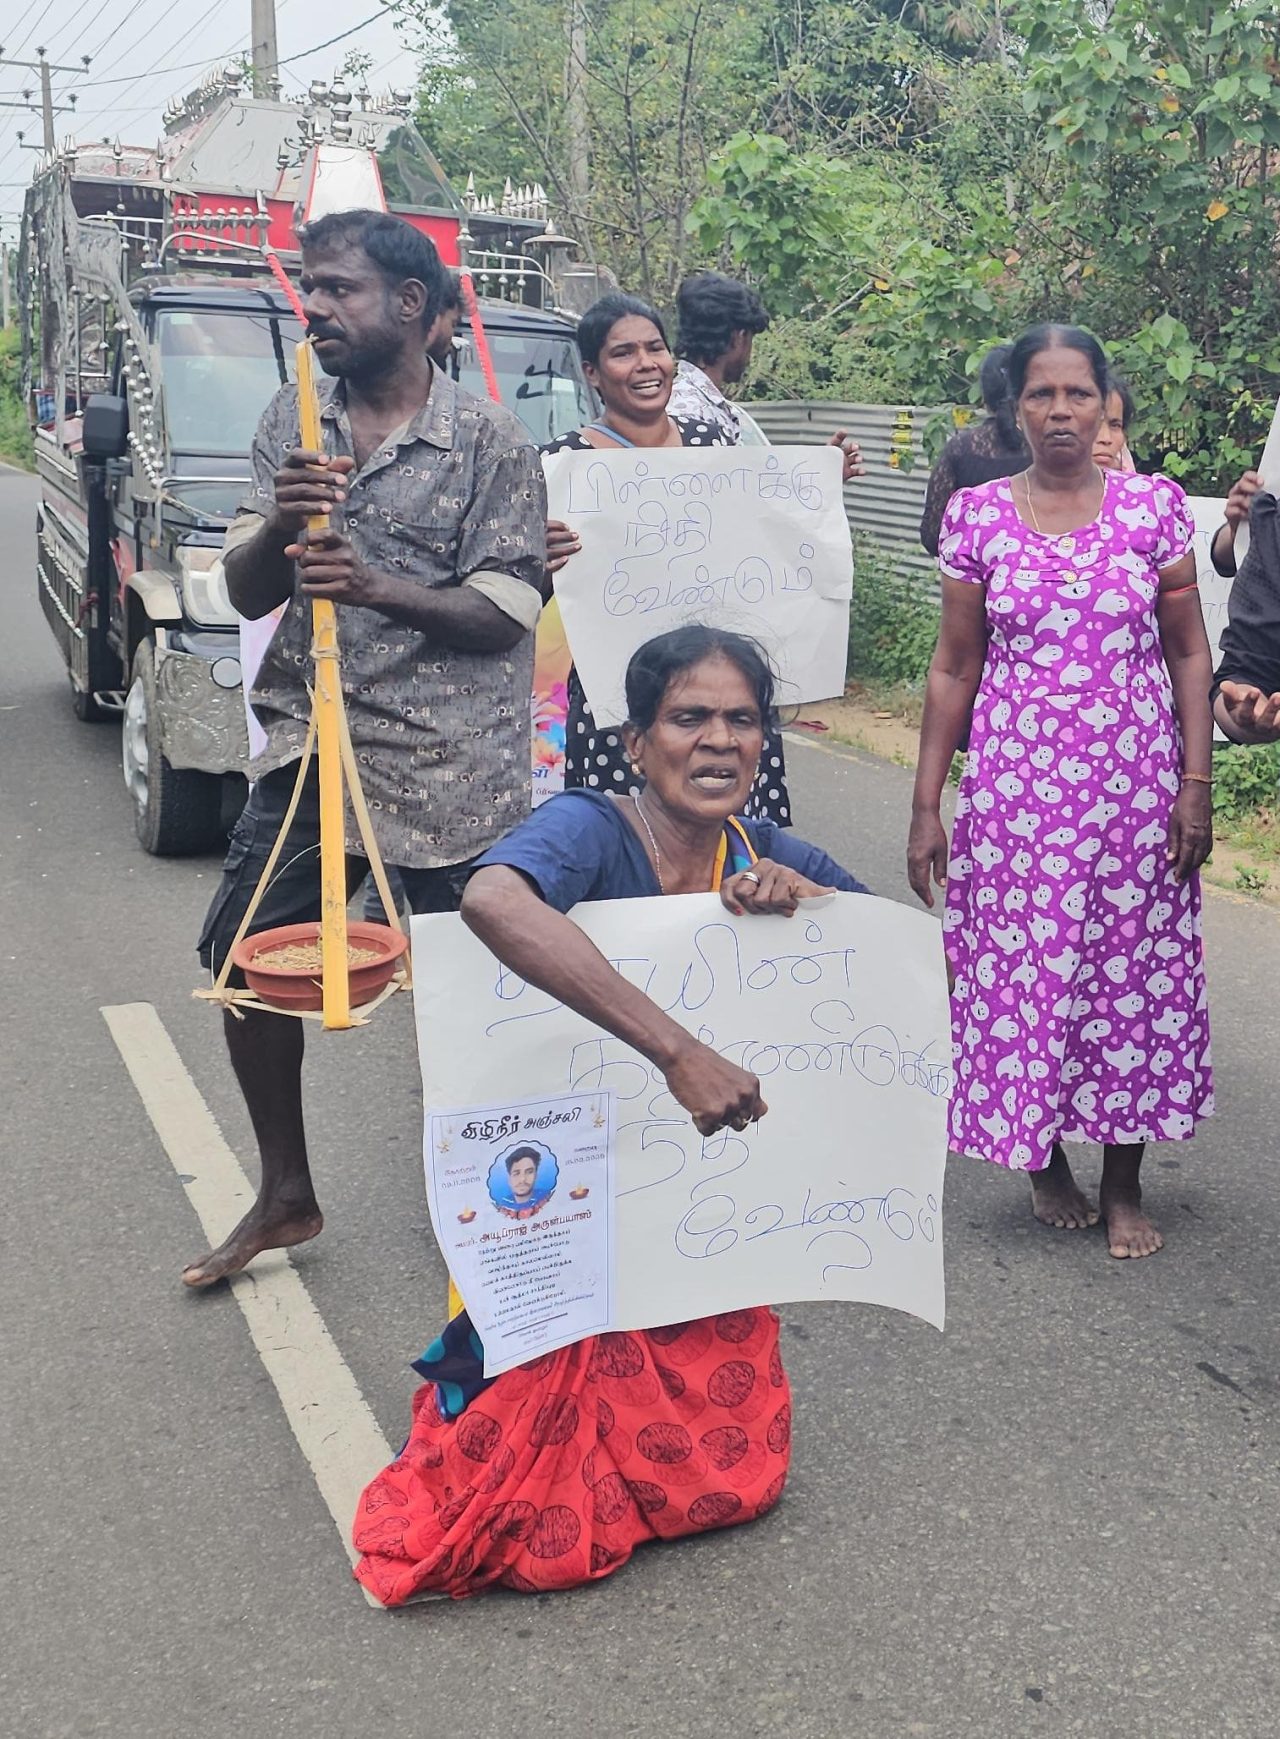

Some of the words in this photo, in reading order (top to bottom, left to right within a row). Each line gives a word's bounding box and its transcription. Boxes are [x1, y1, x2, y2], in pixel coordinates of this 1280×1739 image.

[603, 543, 815, 616] வேண்டும்
[461, 1115, 522, 1144] விழிநீர்
[524, 1107, 581, 1129] அஞ்சலி
